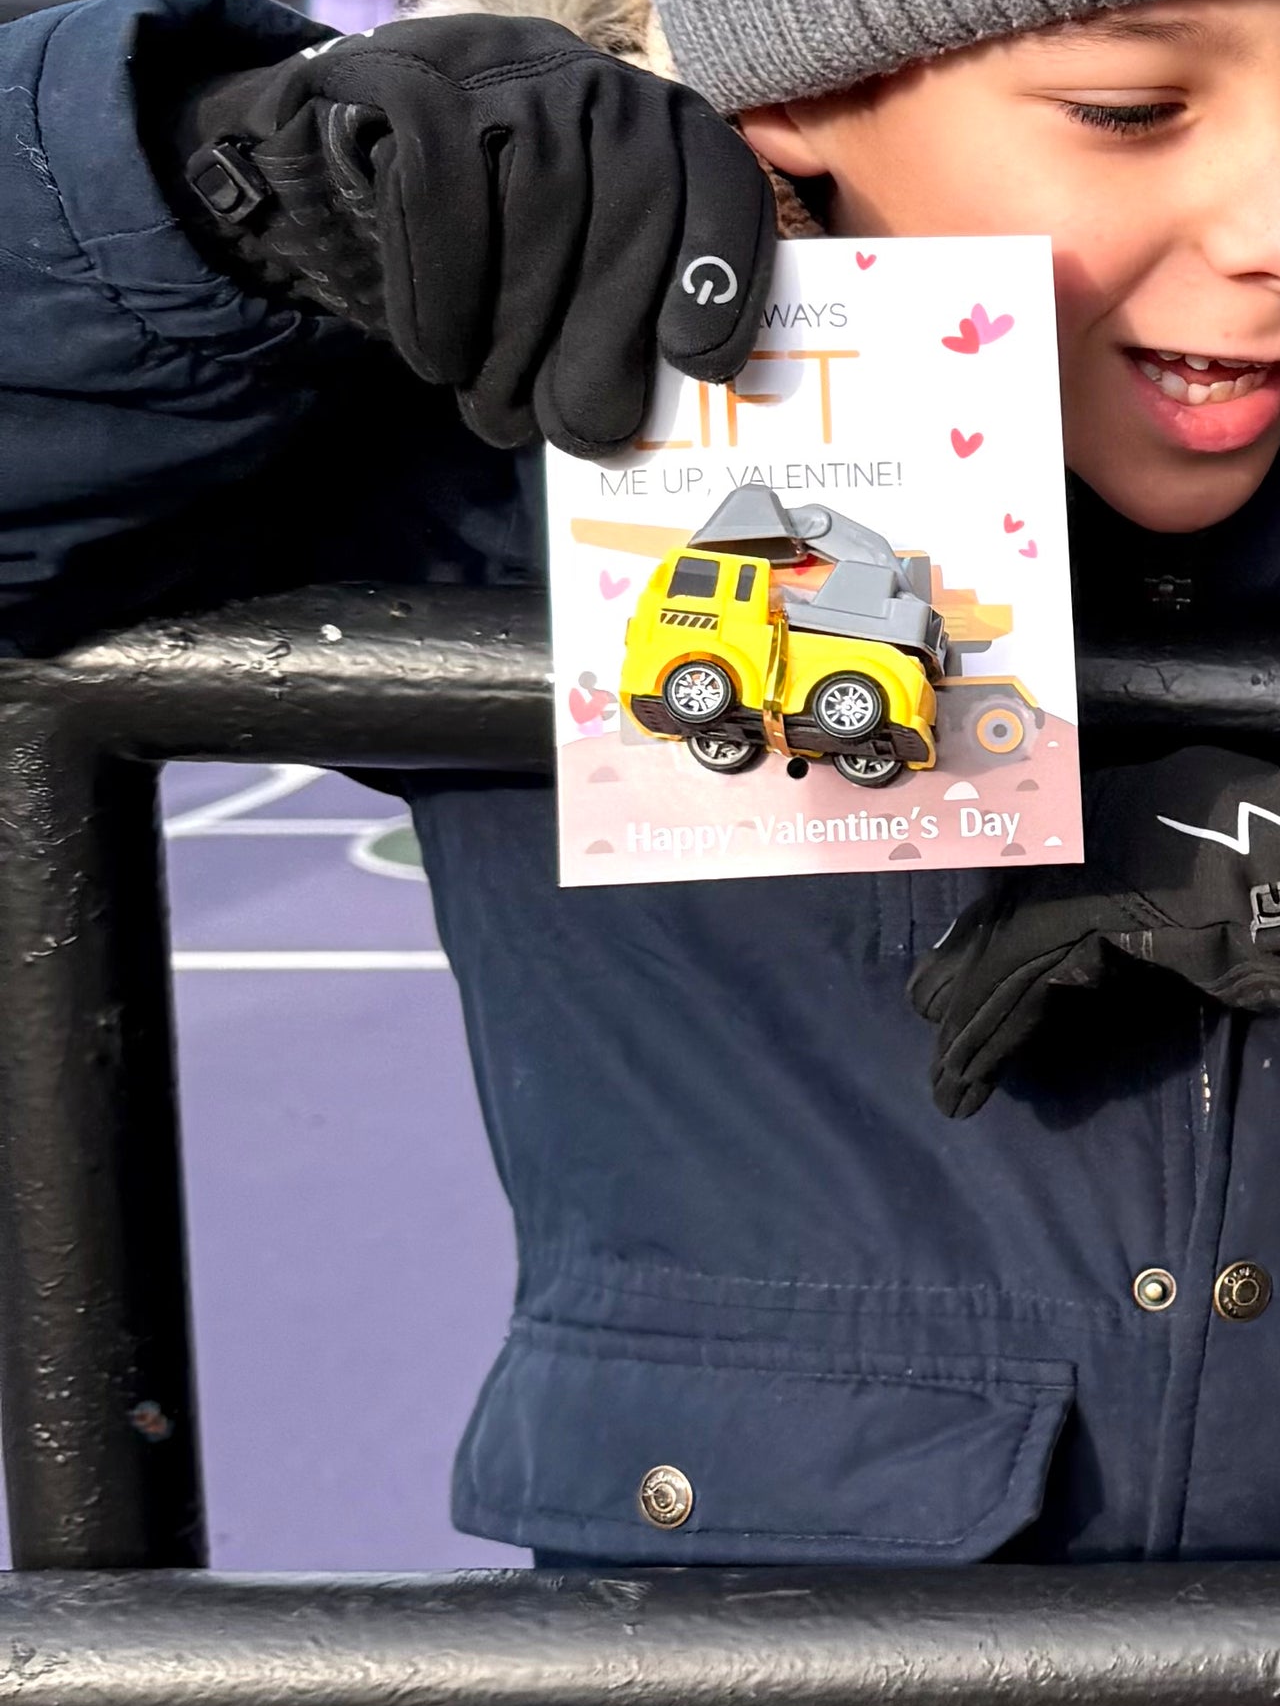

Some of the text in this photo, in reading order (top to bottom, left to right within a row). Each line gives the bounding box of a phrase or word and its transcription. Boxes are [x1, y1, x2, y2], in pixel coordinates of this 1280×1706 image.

[759, 302, 849, 329] WAYS
[600, 460, 904, 497] ME UP, VALENTINE!
[625, 805, 1022, 858] Happy Valentine's Day
